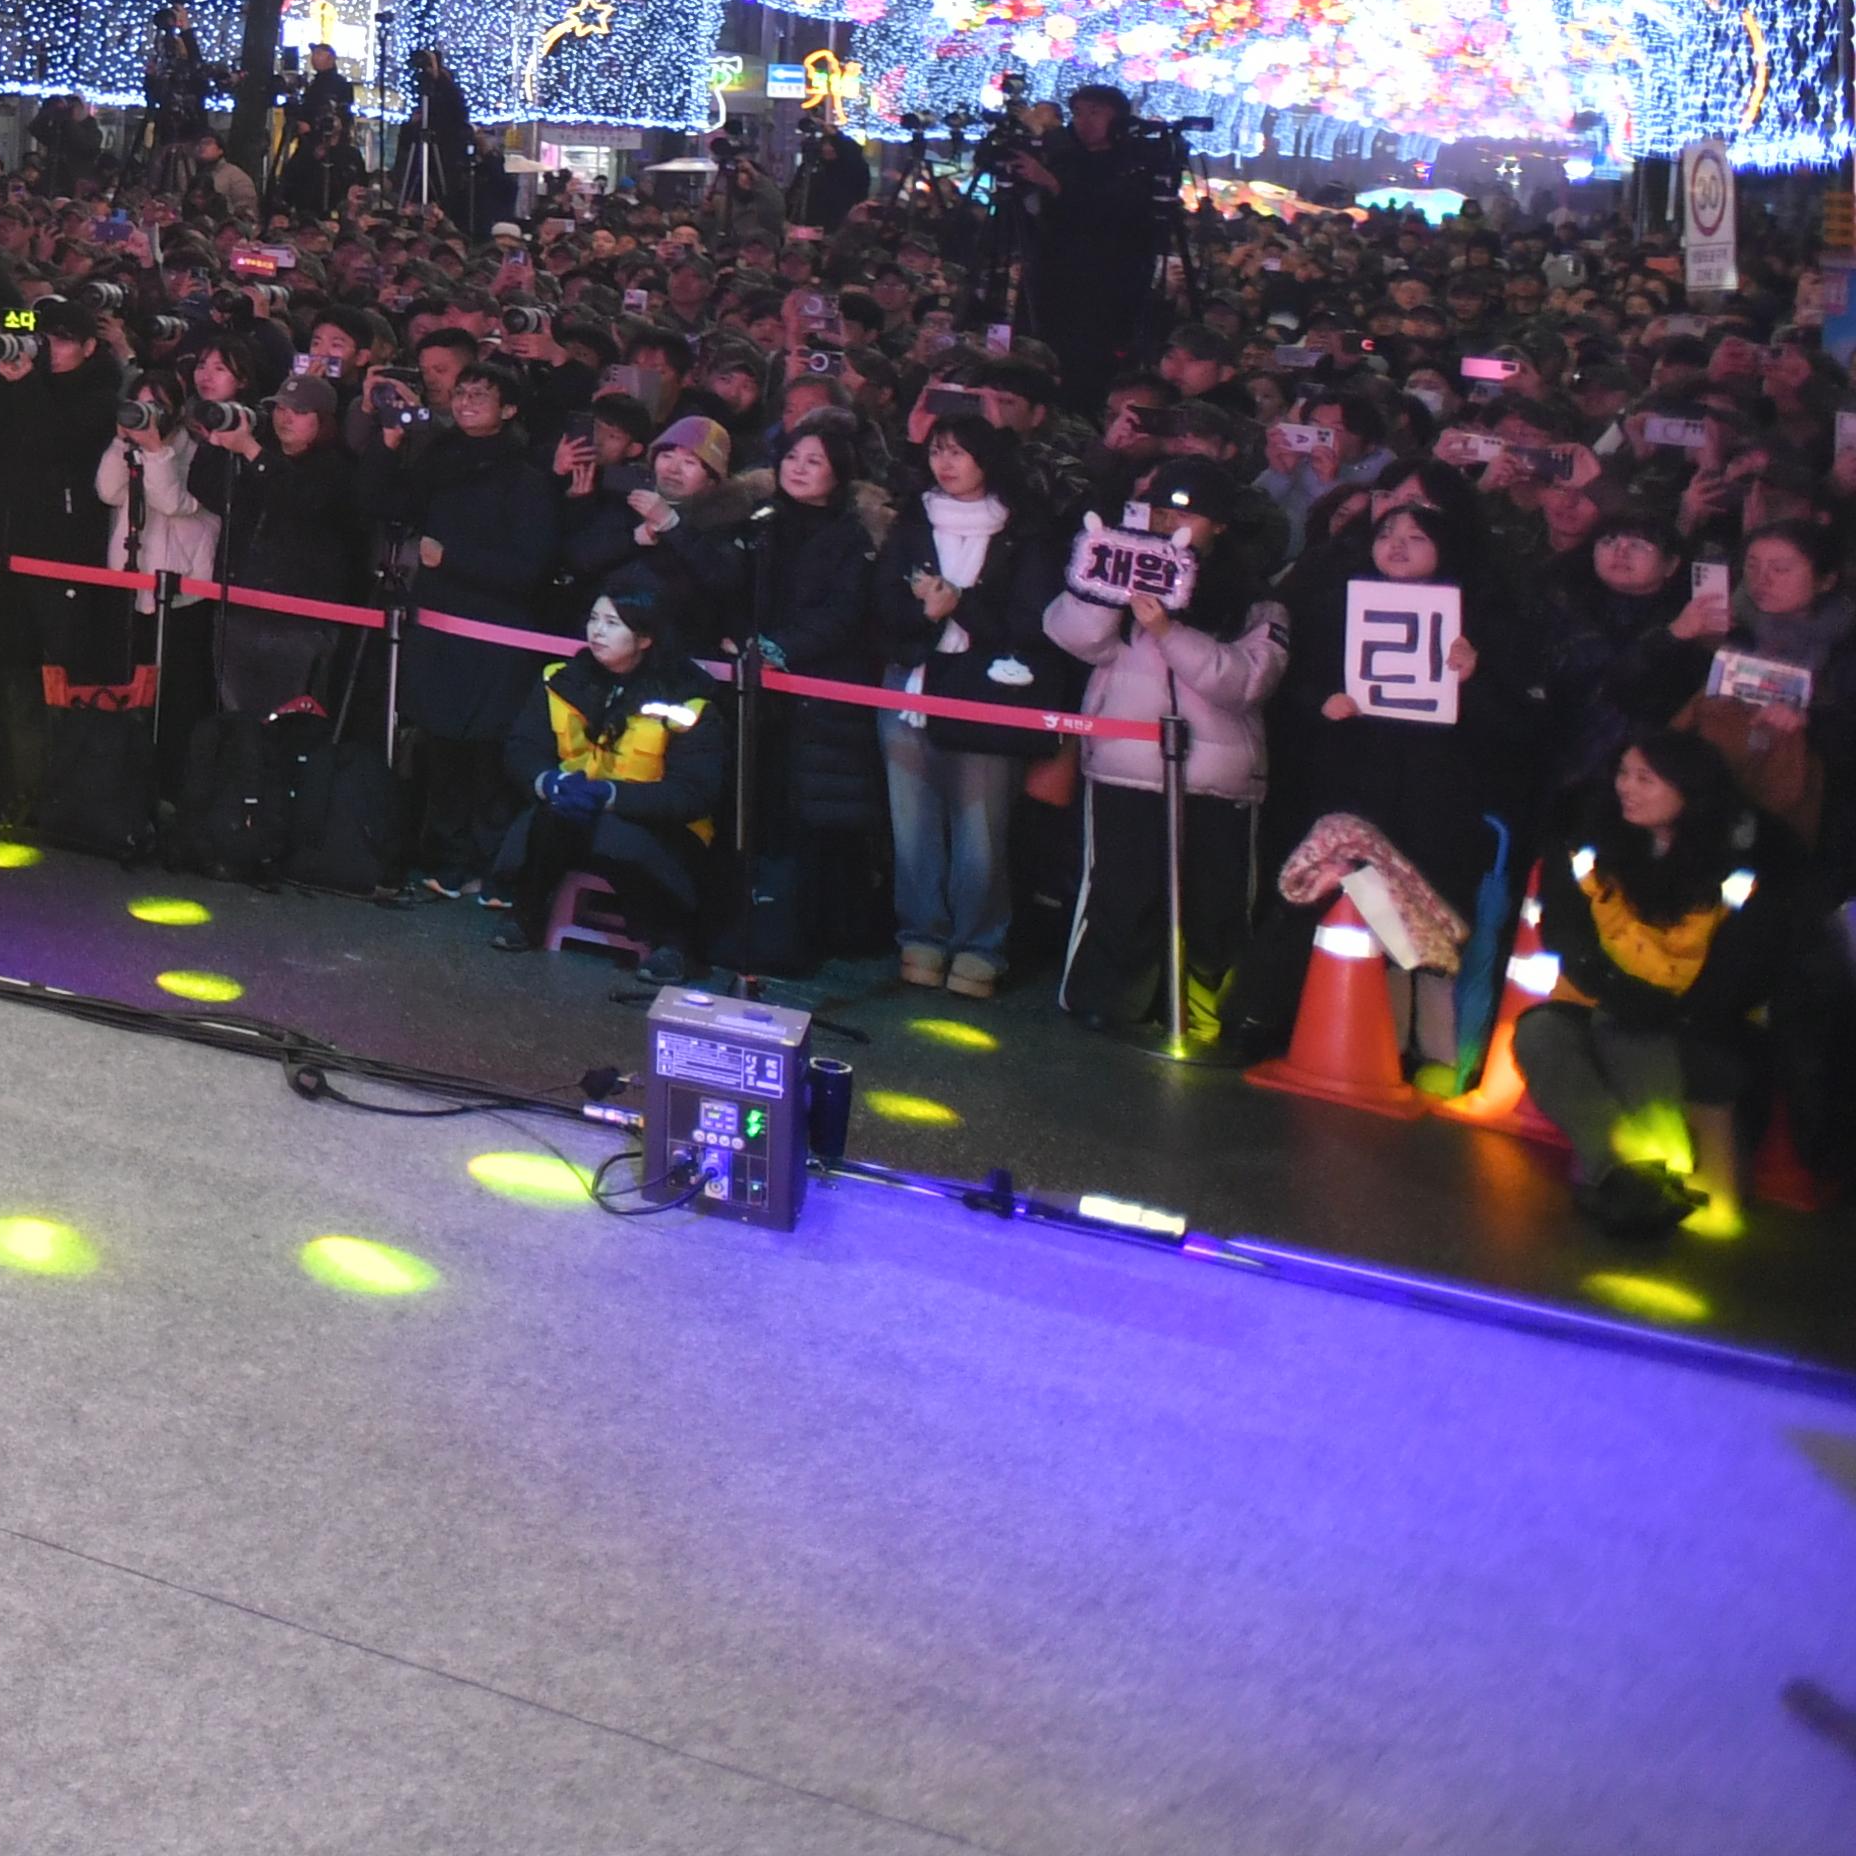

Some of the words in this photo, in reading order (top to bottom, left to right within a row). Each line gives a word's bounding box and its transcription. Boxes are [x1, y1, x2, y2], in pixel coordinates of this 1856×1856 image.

[1696, 175, 1720, 210] 30
[4, 310, 36, 332] 소다
[1086, 544, 1180, 596] 채원
[1359, 609, 1442, 712] 린
